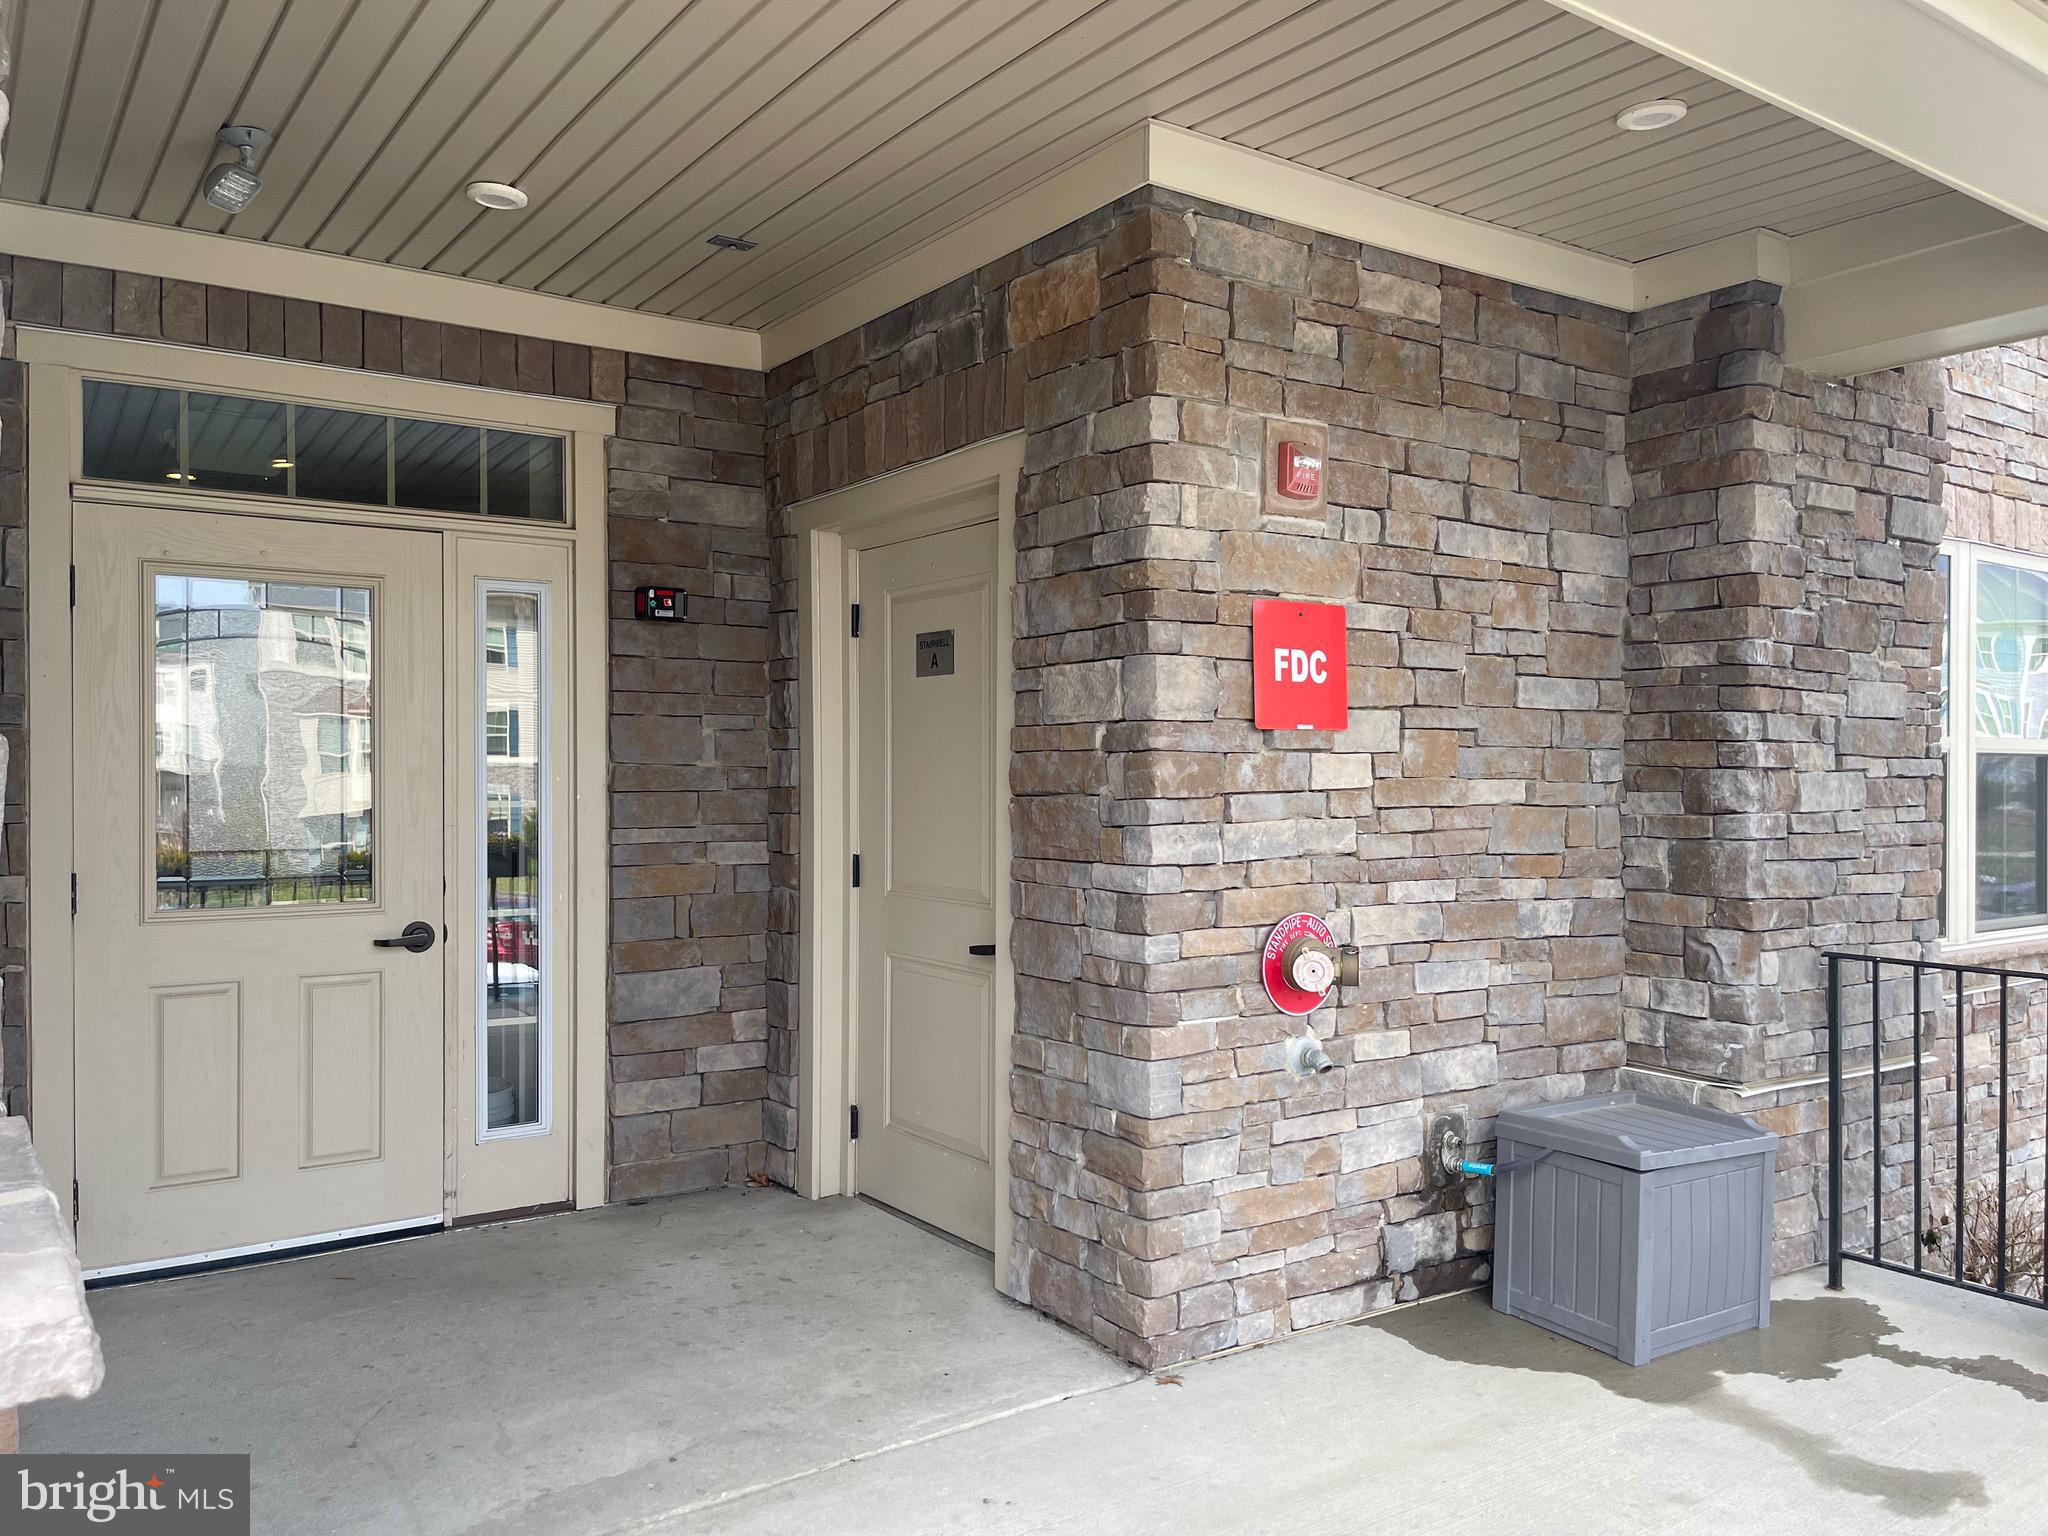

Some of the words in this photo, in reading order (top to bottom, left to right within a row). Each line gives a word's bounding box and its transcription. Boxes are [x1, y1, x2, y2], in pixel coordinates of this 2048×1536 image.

[1296, 472, 1315, 481] FIRE
[920, 638, 950, 649] STAIRWELL
[930, 653, 938, 669] A
[1274, 648, 1327, 684] FDC
